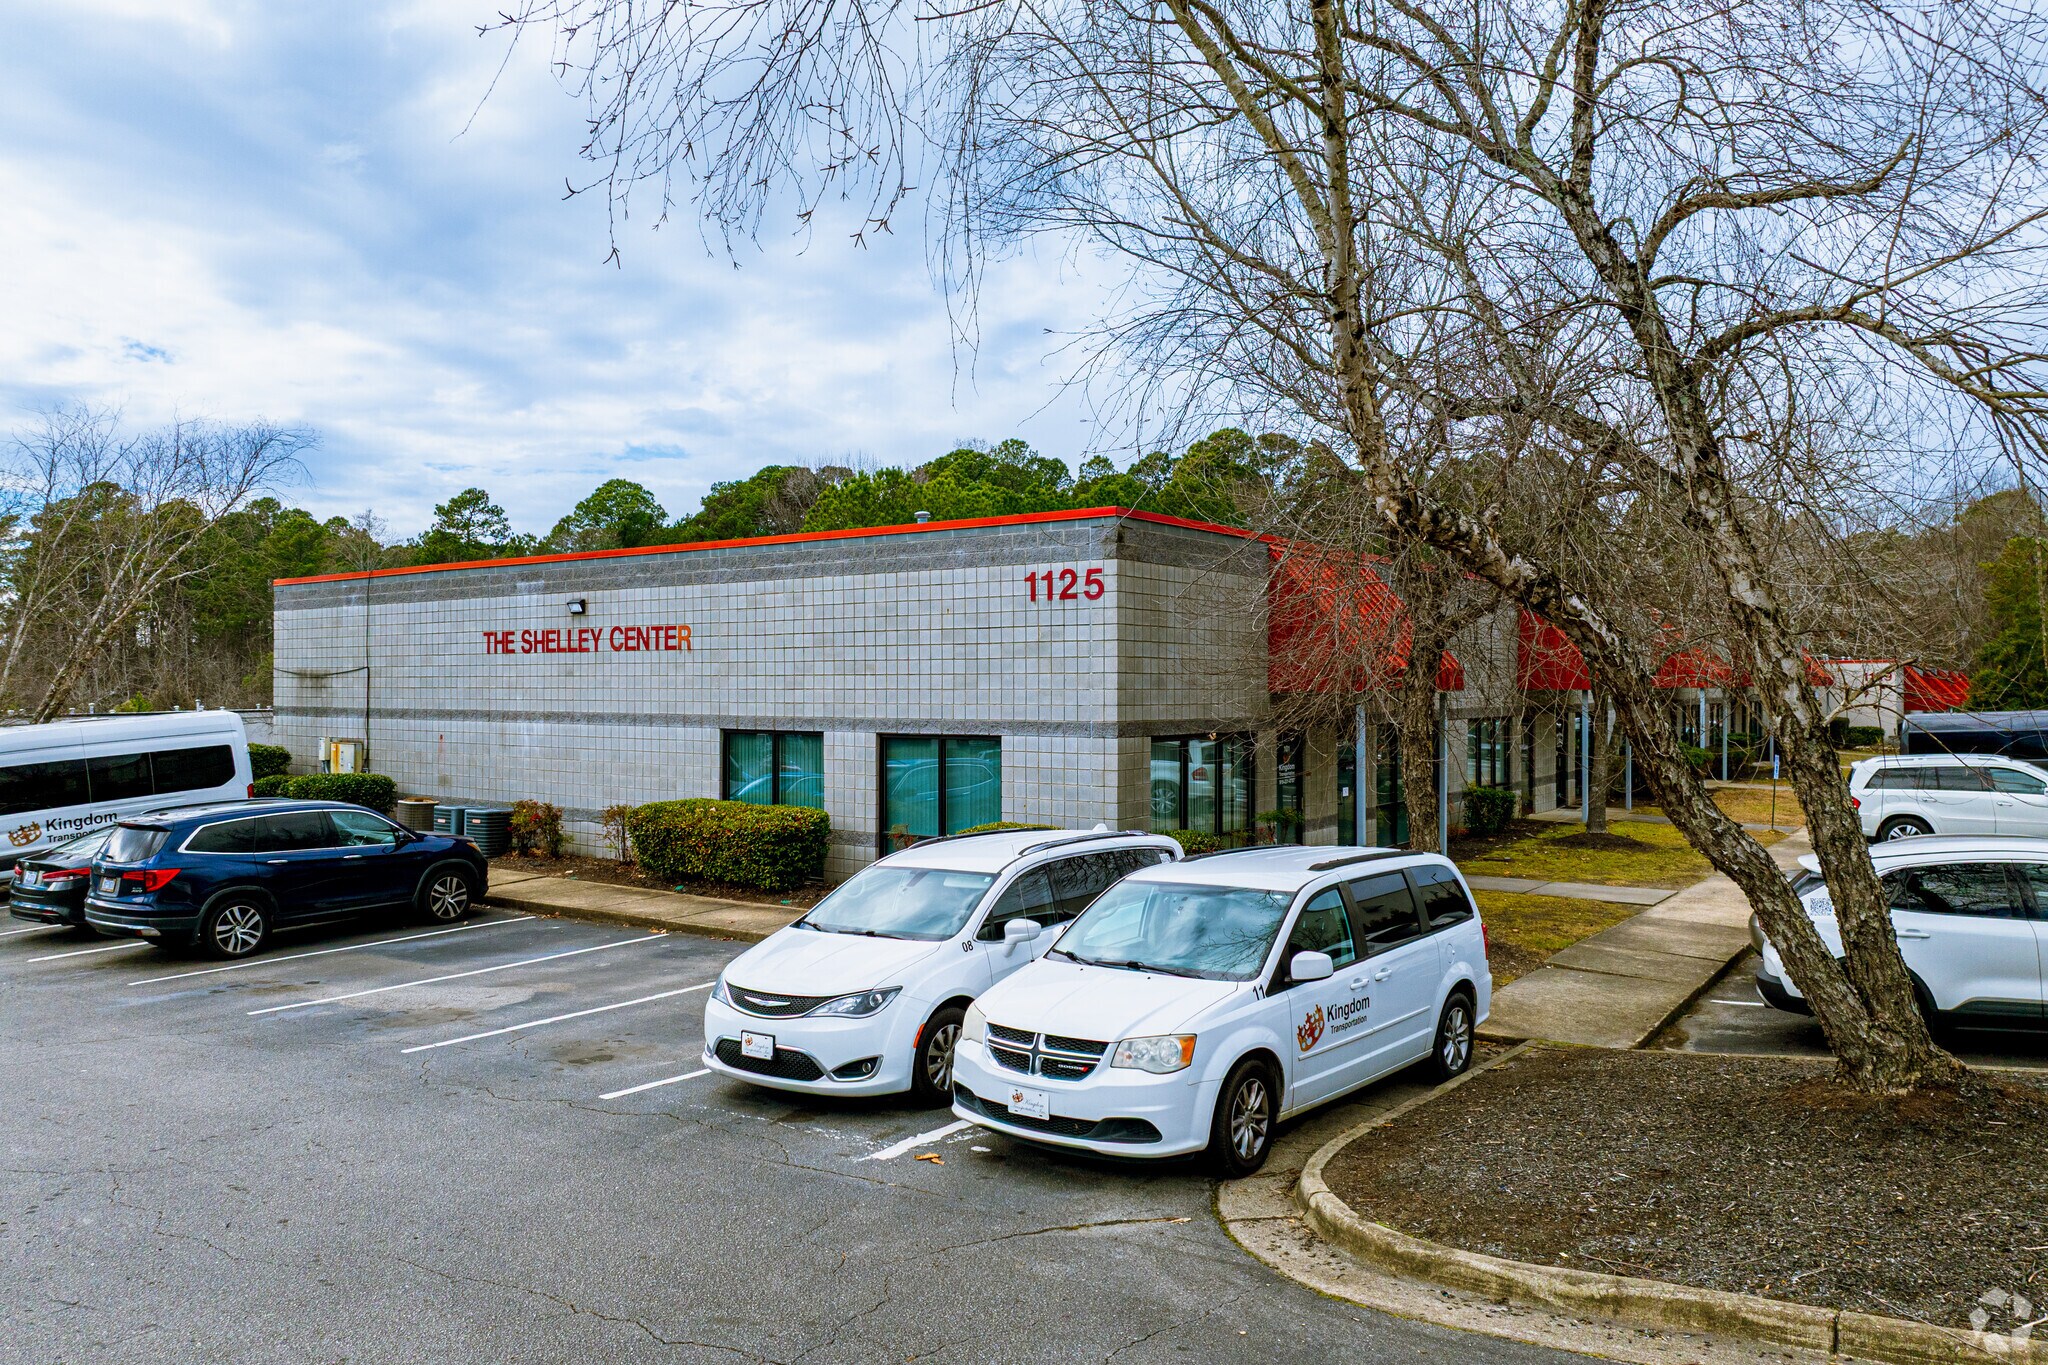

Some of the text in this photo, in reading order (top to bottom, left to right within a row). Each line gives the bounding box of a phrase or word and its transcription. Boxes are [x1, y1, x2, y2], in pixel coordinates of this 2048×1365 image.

[1024, 567, 1105, 602] 1125
[484, 625, 692, 654] THE SHELLEY CENTER
[46, 812, 117, 831] Kingdom
[961, 940, 974, 952] 08
[1253, 984, 1266, 1000] 11
[1327, 996, 1370, 1022] Kingdom
[1330, 1015, 1367, 1034] Transportation
